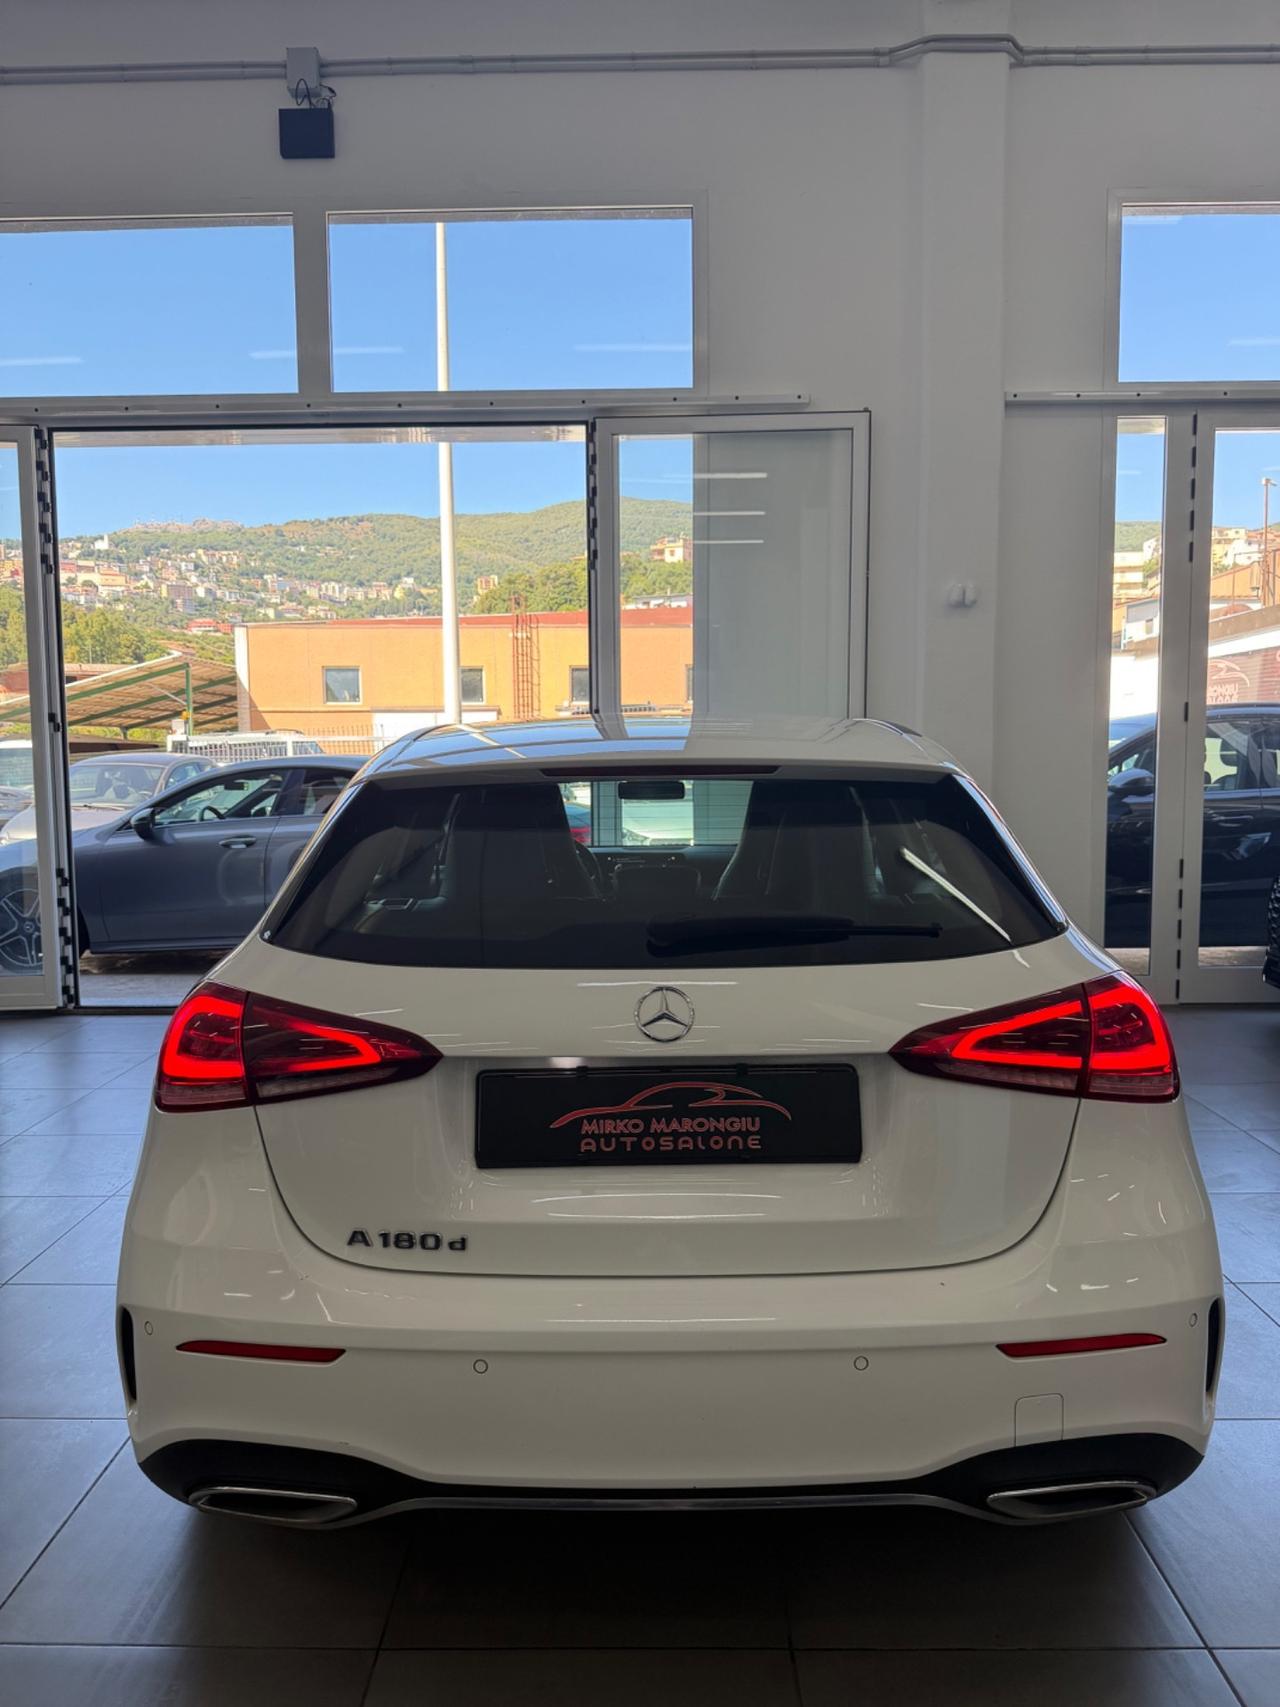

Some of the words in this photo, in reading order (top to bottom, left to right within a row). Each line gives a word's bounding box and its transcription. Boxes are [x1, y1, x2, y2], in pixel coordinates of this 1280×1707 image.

[581, 1119, 644, 1134] MIRKO
[650, 1117, 761, 1132] MARONGIU
[580, 1136, 762, 1152] AUTOSALONE
